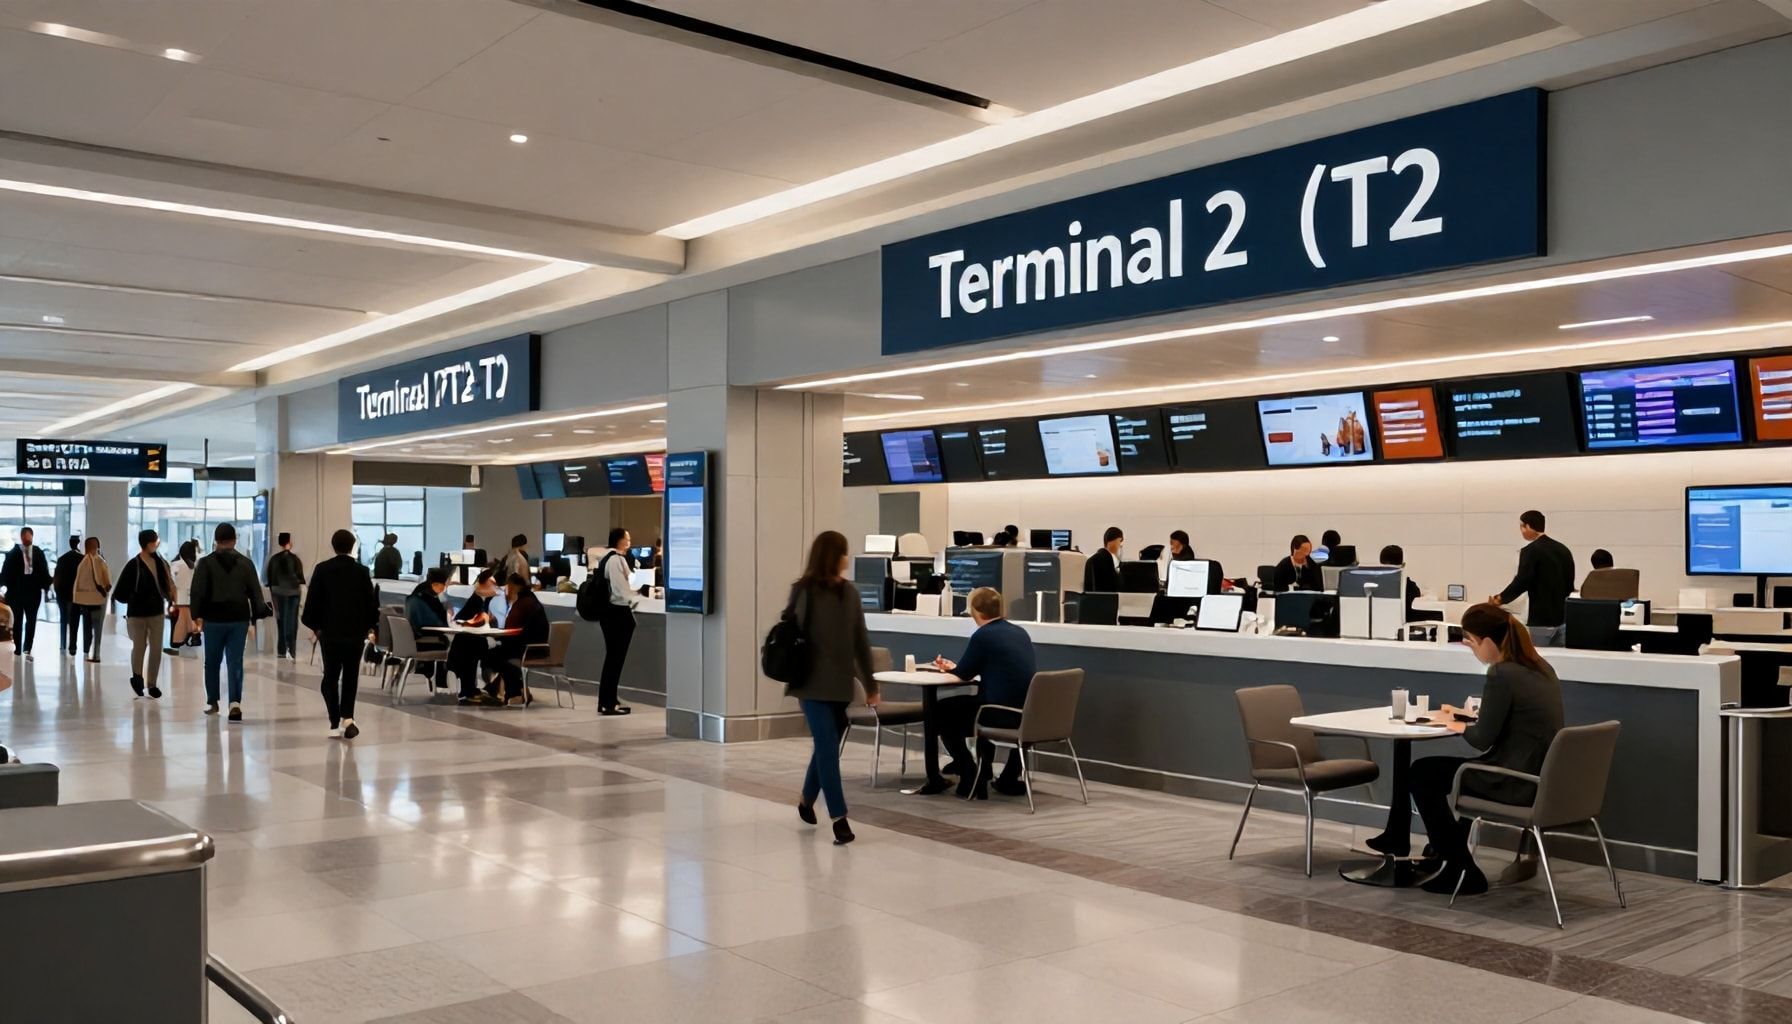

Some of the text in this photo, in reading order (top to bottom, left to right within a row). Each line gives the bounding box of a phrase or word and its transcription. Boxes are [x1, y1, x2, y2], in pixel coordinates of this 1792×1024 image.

[928, 147, 1443, 319] Terminal 2 (T2
